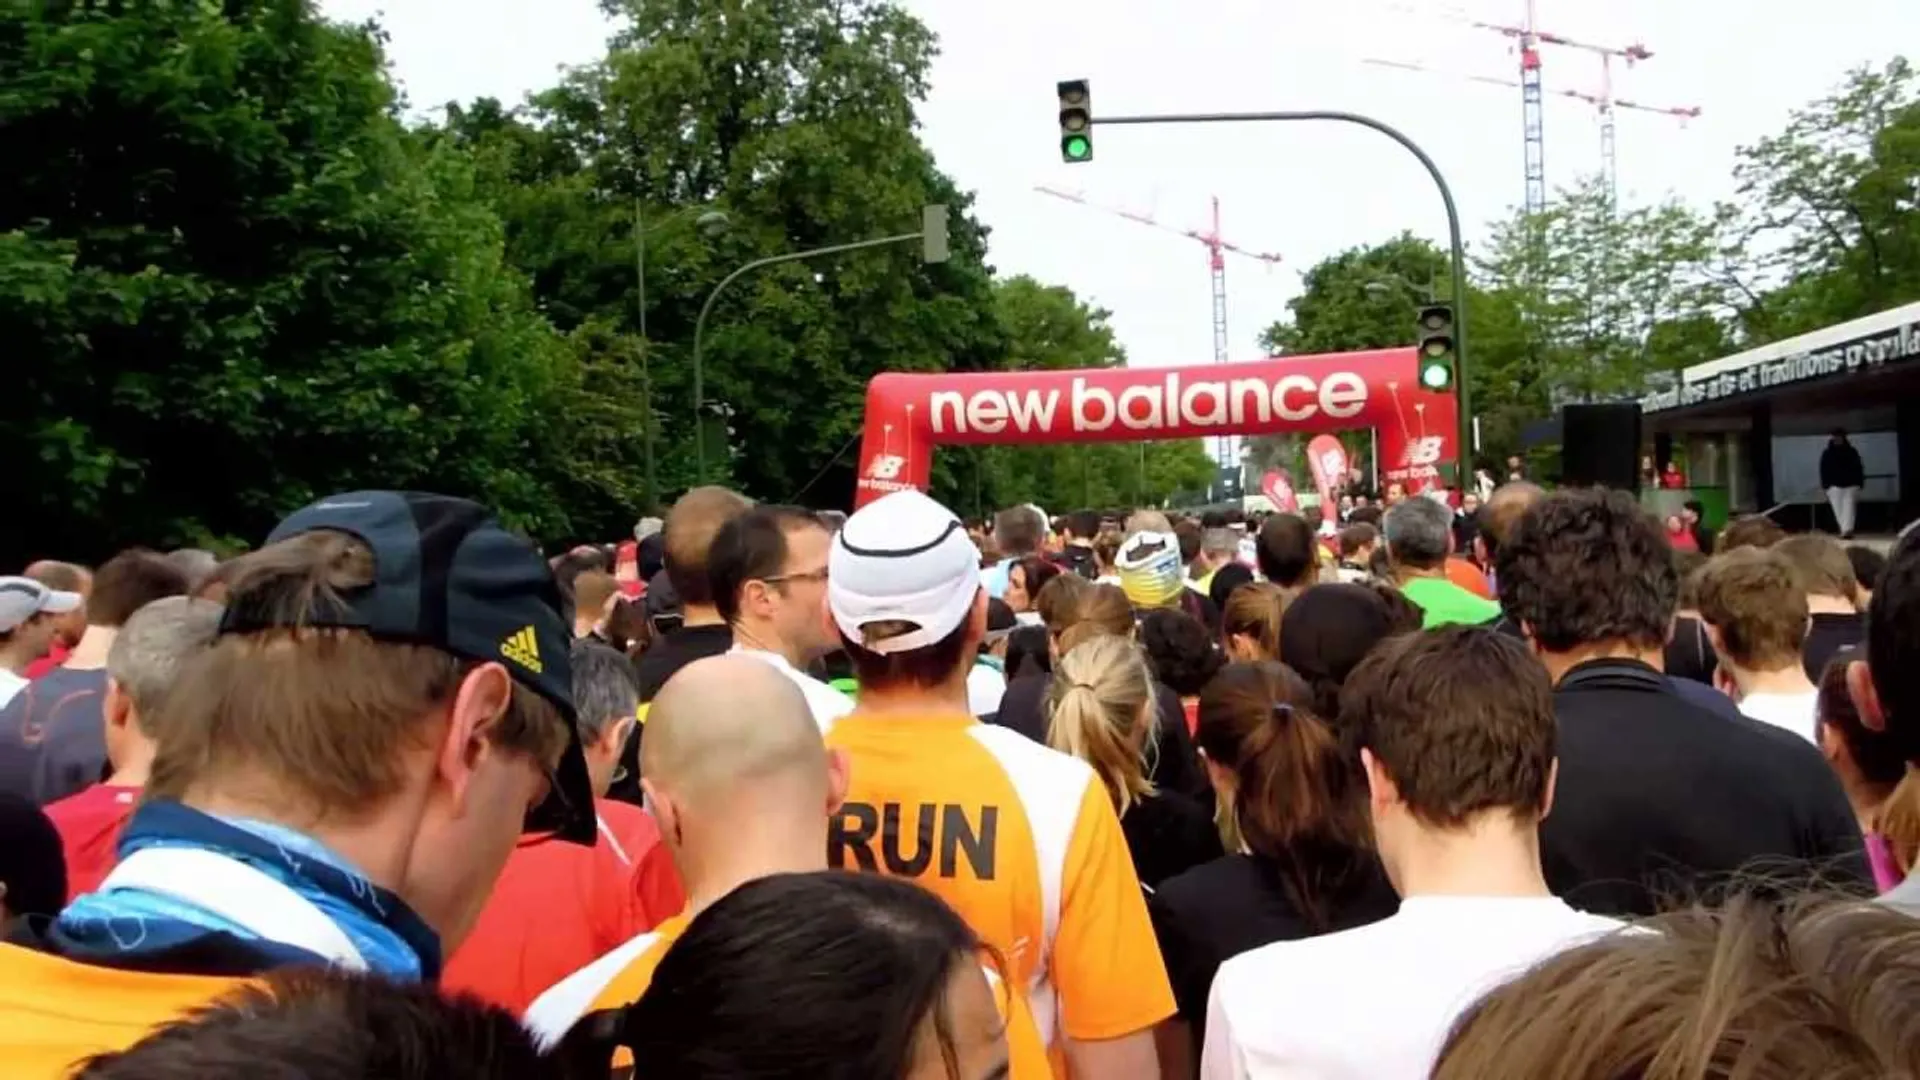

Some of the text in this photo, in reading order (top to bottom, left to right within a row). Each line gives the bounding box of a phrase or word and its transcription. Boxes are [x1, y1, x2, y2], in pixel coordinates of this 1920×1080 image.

[930, 371, 1369, 433] new balance
[1739, 366, 1758, 392] et
[1760, 350, 1844, 387] traditions
[826, 801, 998, 881] RUN
